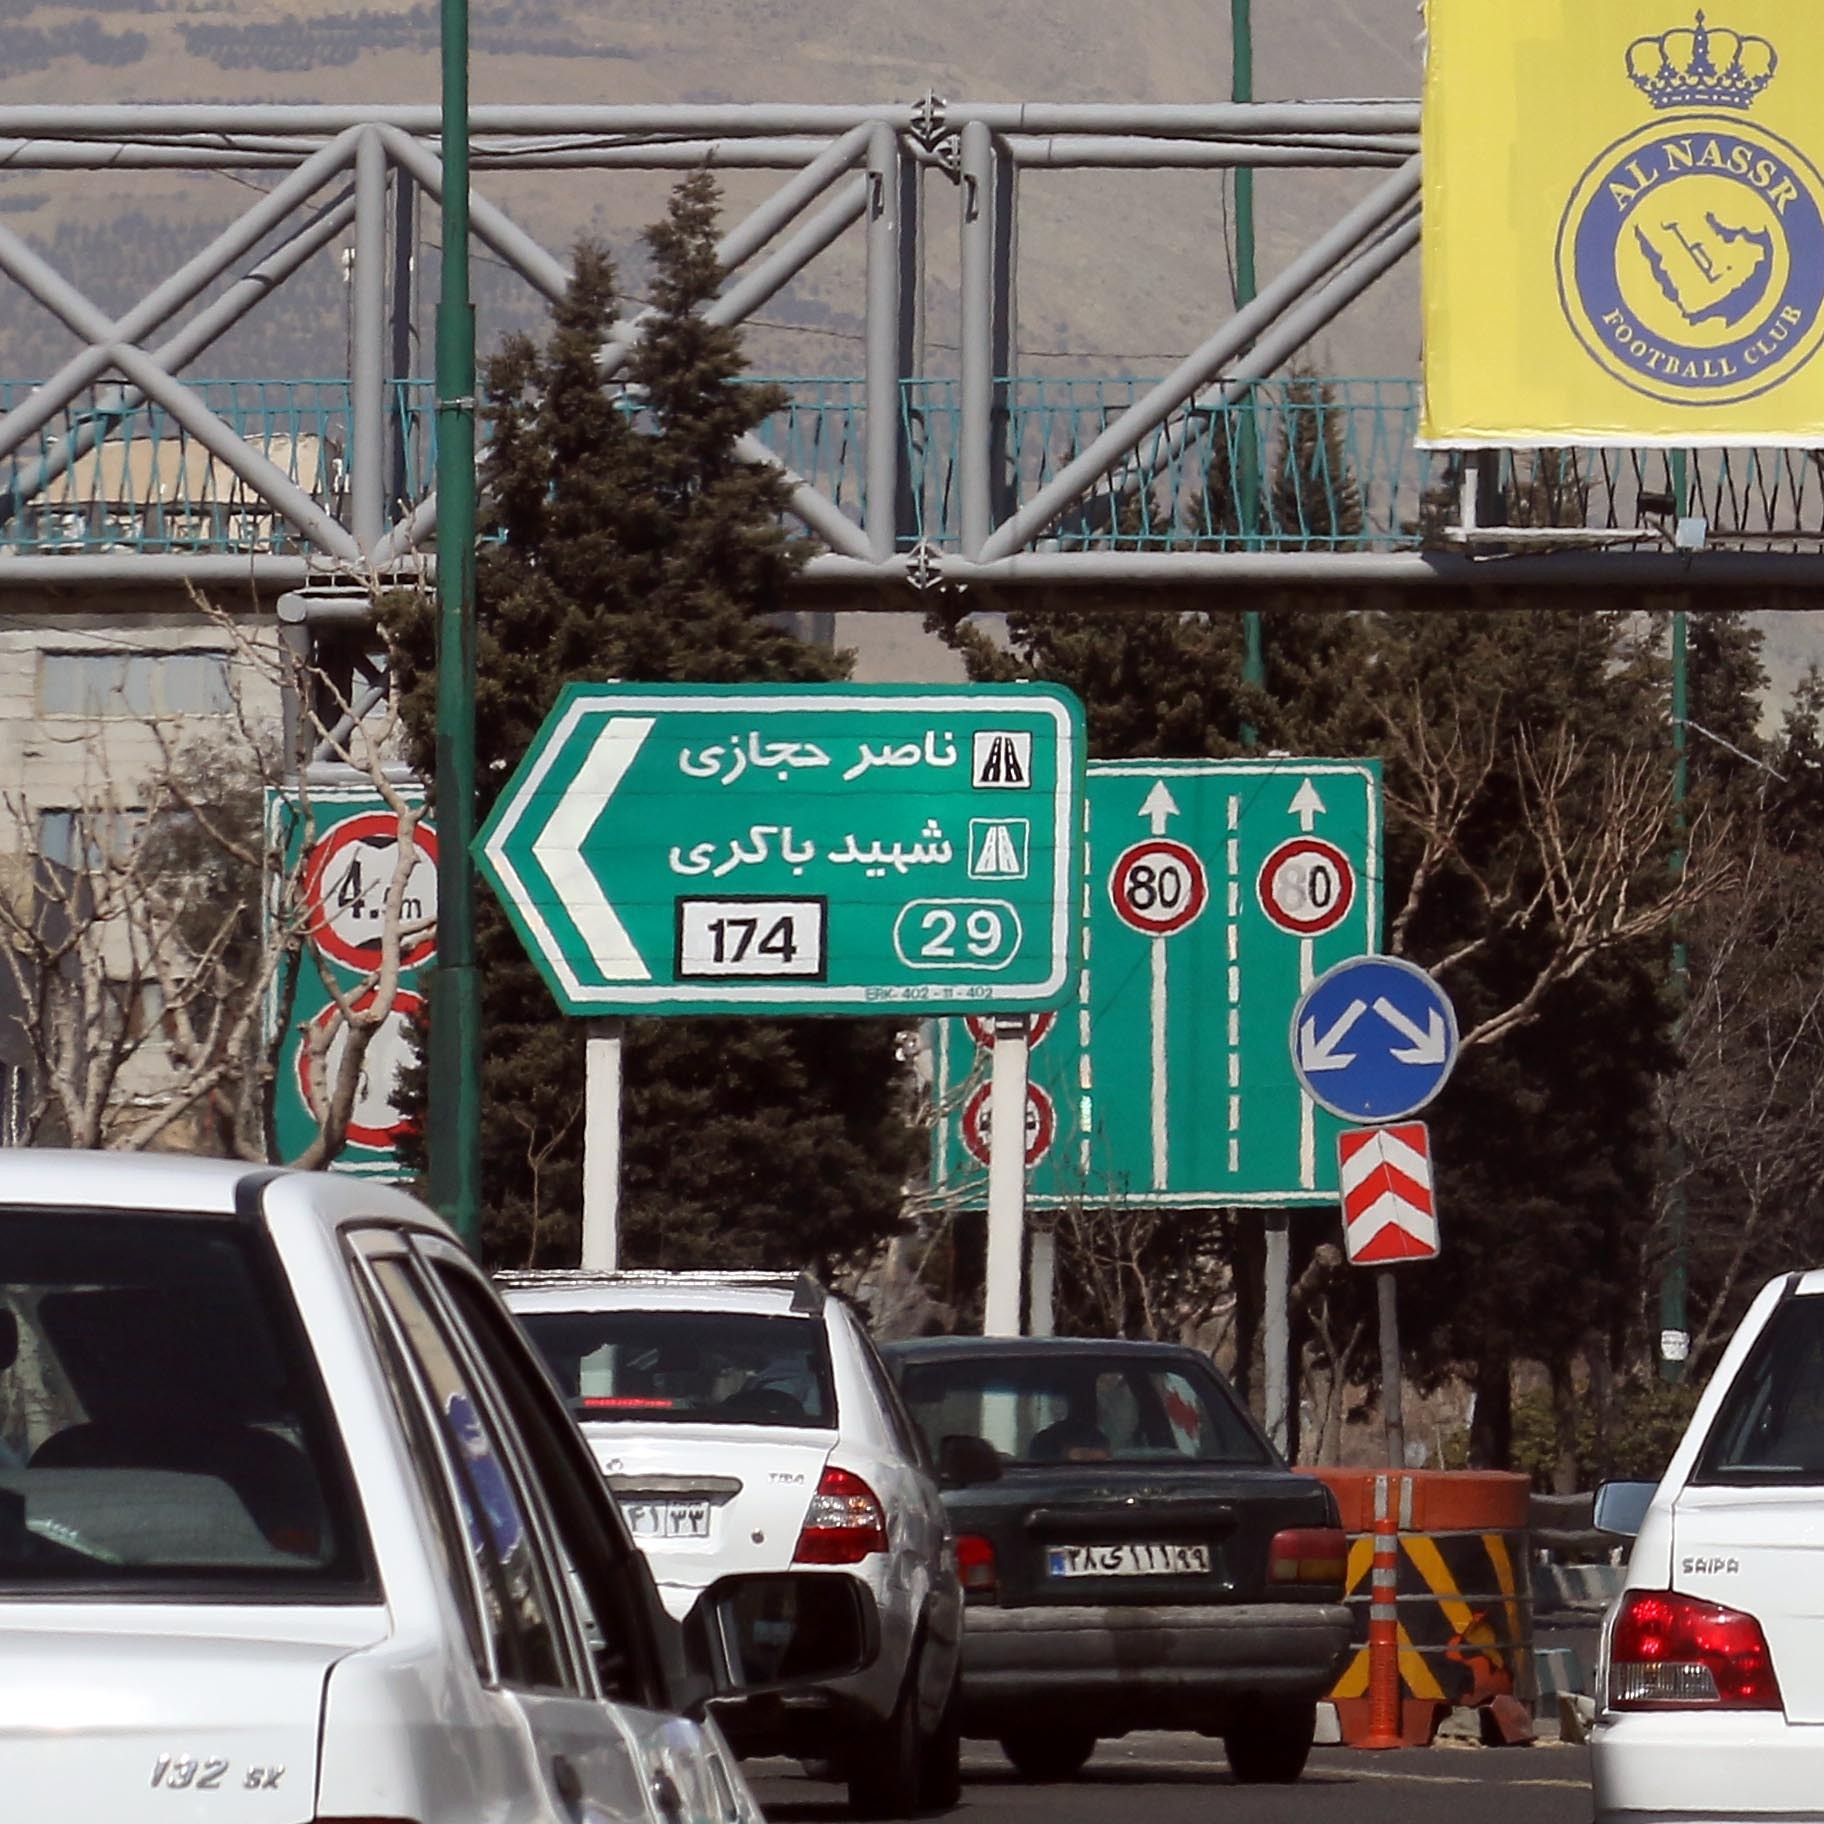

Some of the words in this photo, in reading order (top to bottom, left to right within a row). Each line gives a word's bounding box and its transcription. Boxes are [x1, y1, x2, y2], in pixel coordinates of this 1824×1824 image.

[1608, 159, 1660, 212] AL
[1662, 138, 1800, 216] NASSR
[1602, 307, 1738, 379] FOOTBALL
[1743, 304, 1803, 366] CLUB
[678, 730, 831, 785] حجازی
[843, 730, 957, 780] ناصر
[669, 825, 815, 877] باکری
[827, 819, 953, 875] شهید
[338, 861, 422, 919] 4.m
[1126, 865, 1182, 911] 80
[708, 916, 798, 964] 174
[920, 909, 1003, 958] 29
[1681, 1557, 1739, 1575] SAIPA
[150, 1752, 230, 1789] 132
